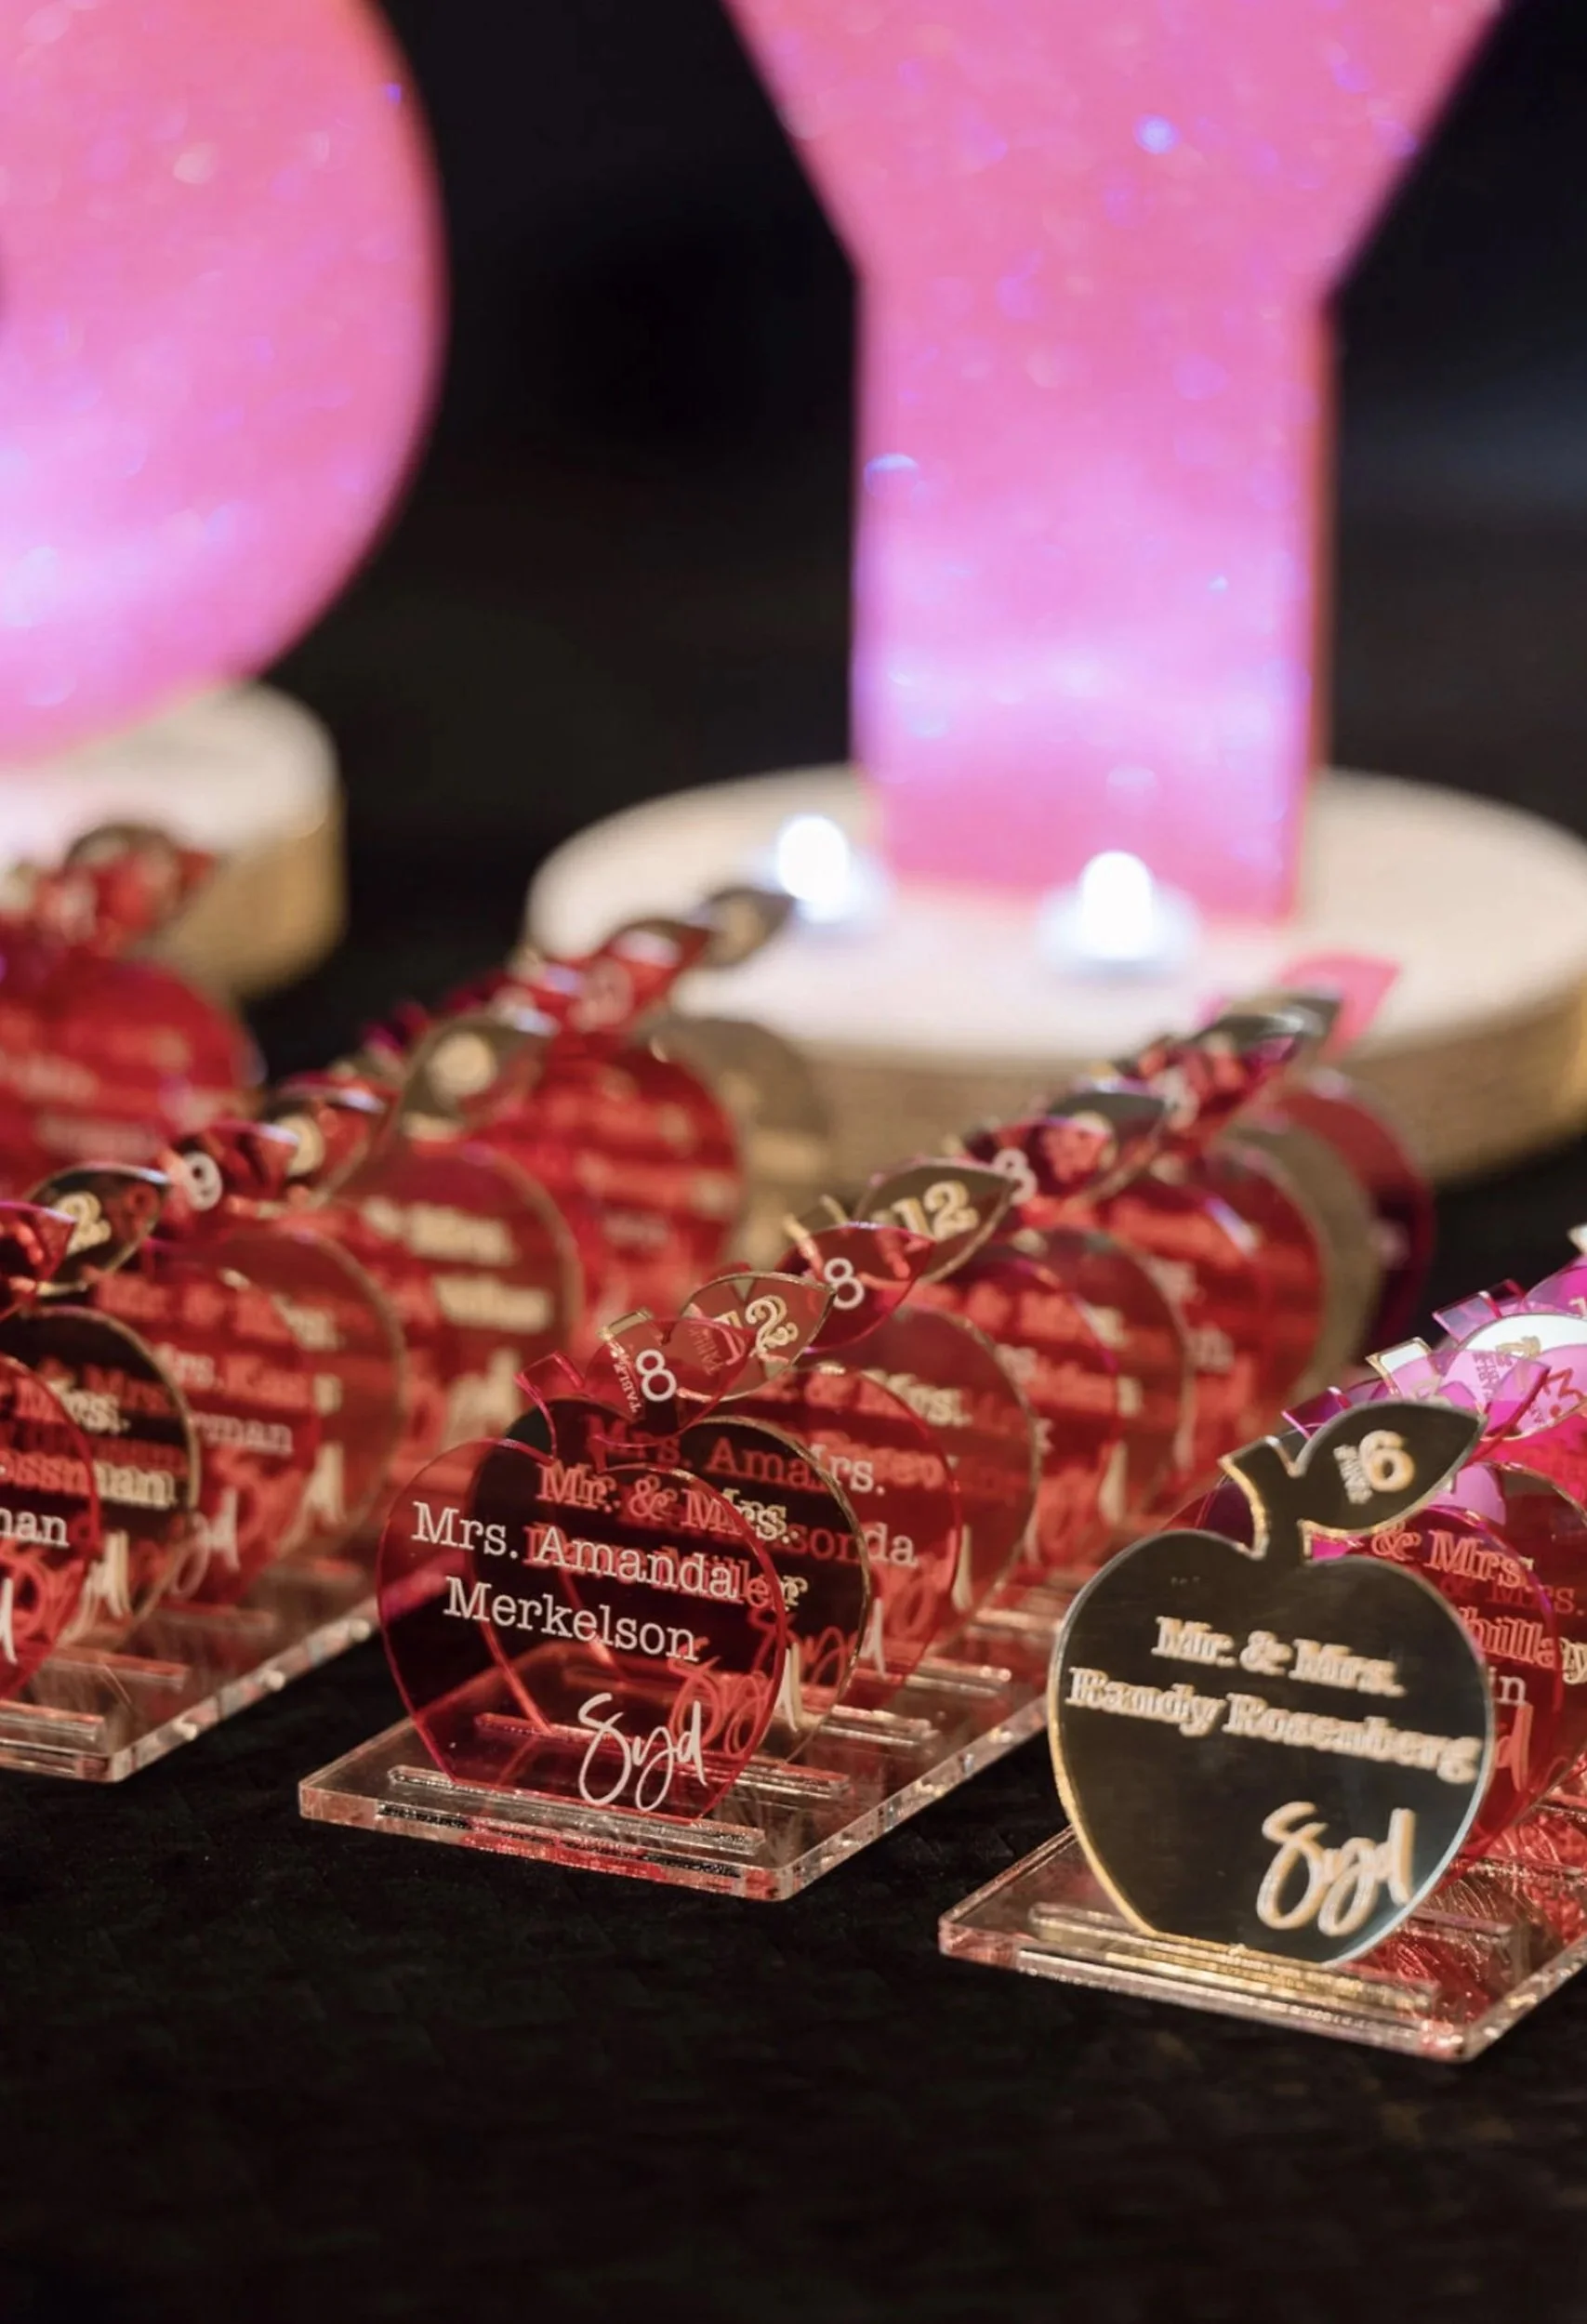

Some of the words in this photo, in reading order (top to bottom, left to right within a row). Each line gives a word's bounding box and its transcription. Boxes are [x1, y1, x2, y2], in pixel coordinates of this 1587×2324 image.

[636, 1348, 677, 1402] 8
[1358, 1429, 1415, 1493] 6
[411, 1499, 519, 1560] Mrs.
[531, 1525, 741, 1600] Amanda
[442, 1574, 699, 1663] Merkelson
[1150, 1615, 1237, 1668] Mr.
[1239, 1629, 1293, 1676] &
[1288, 1637, 1407, 1697] Mrs.
[577, 1691, 709, 1813] Syd
[1064, 1666, 1225, 1738] Randy
[1221, 1691, 1486, 1785] Rosenberg
